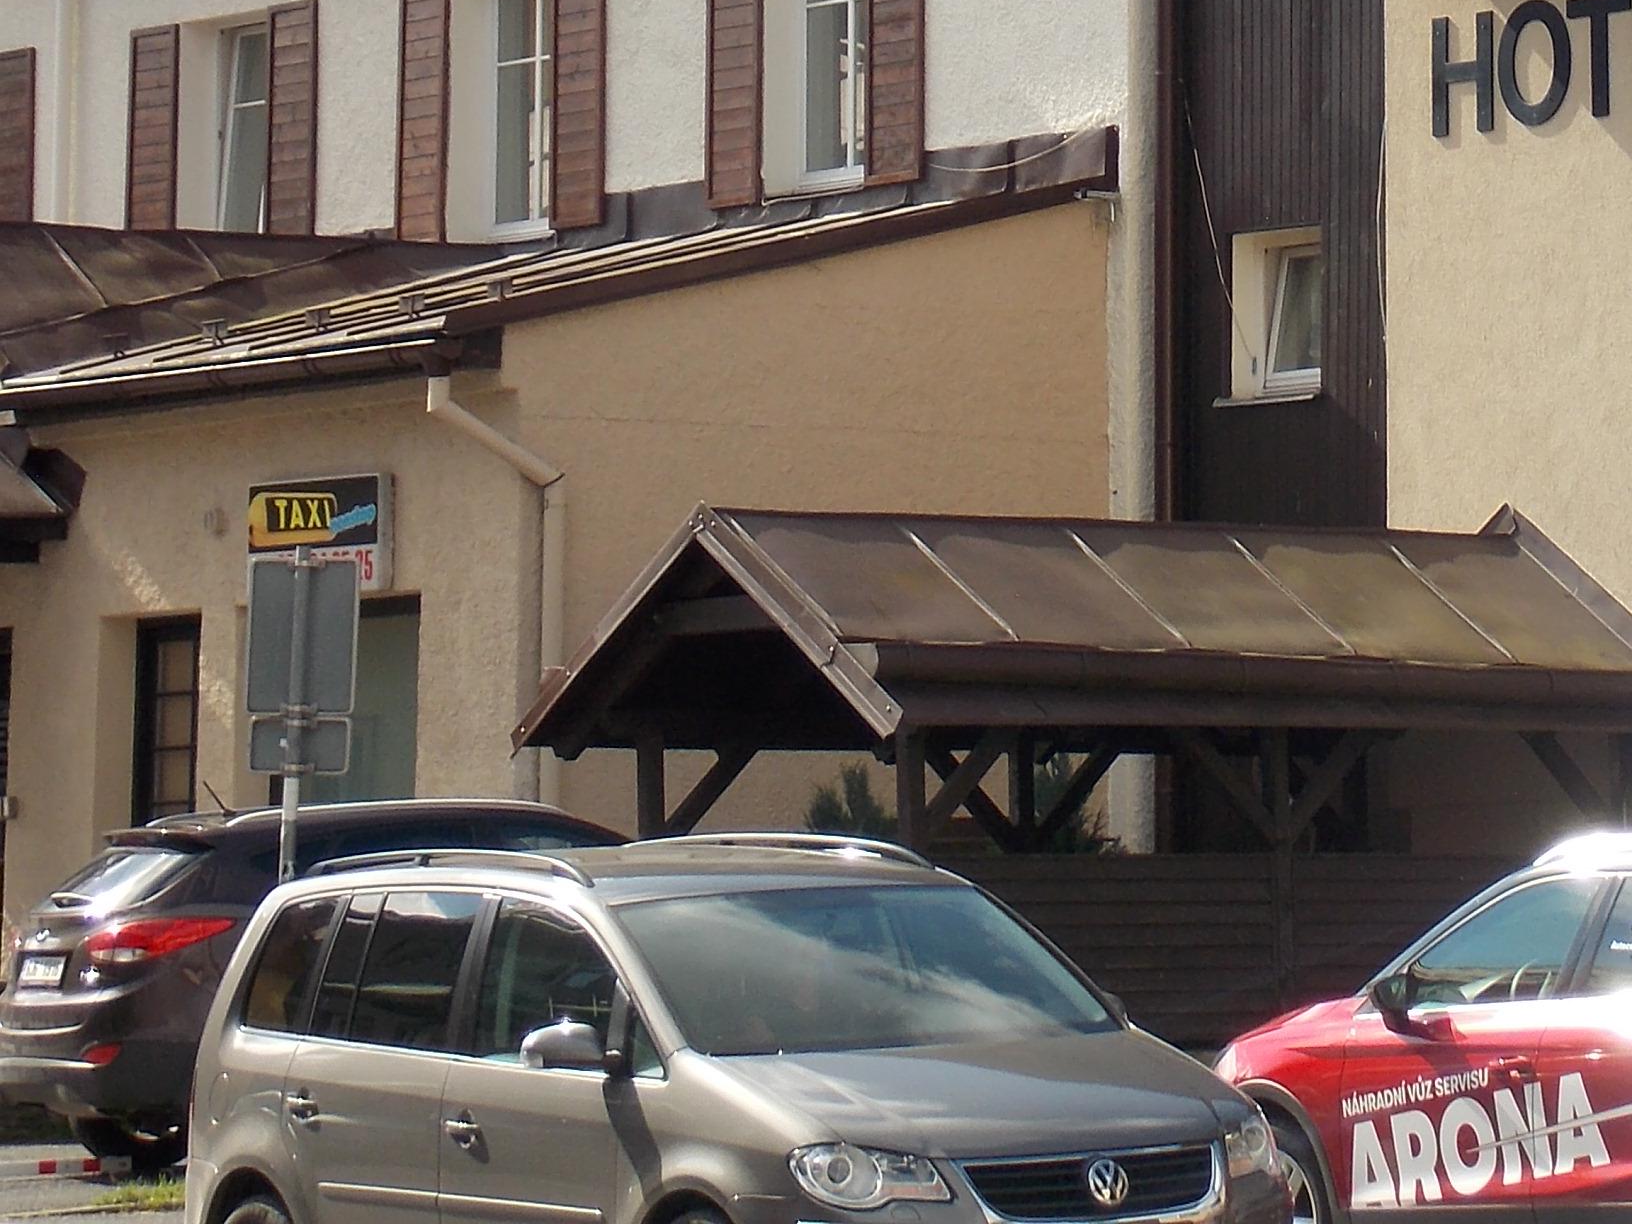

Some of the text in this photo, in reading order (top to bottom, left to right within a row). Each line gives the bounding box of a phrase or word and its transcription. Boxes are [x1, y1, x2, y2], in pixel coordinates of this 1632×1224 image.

[274, 498, 331, 529] TAXI
[1342, 1067, 1489, 1118] NÁHRADNÍ VŮZ SERVISU
[1351, 1072, 1611, 1209] ARONA
